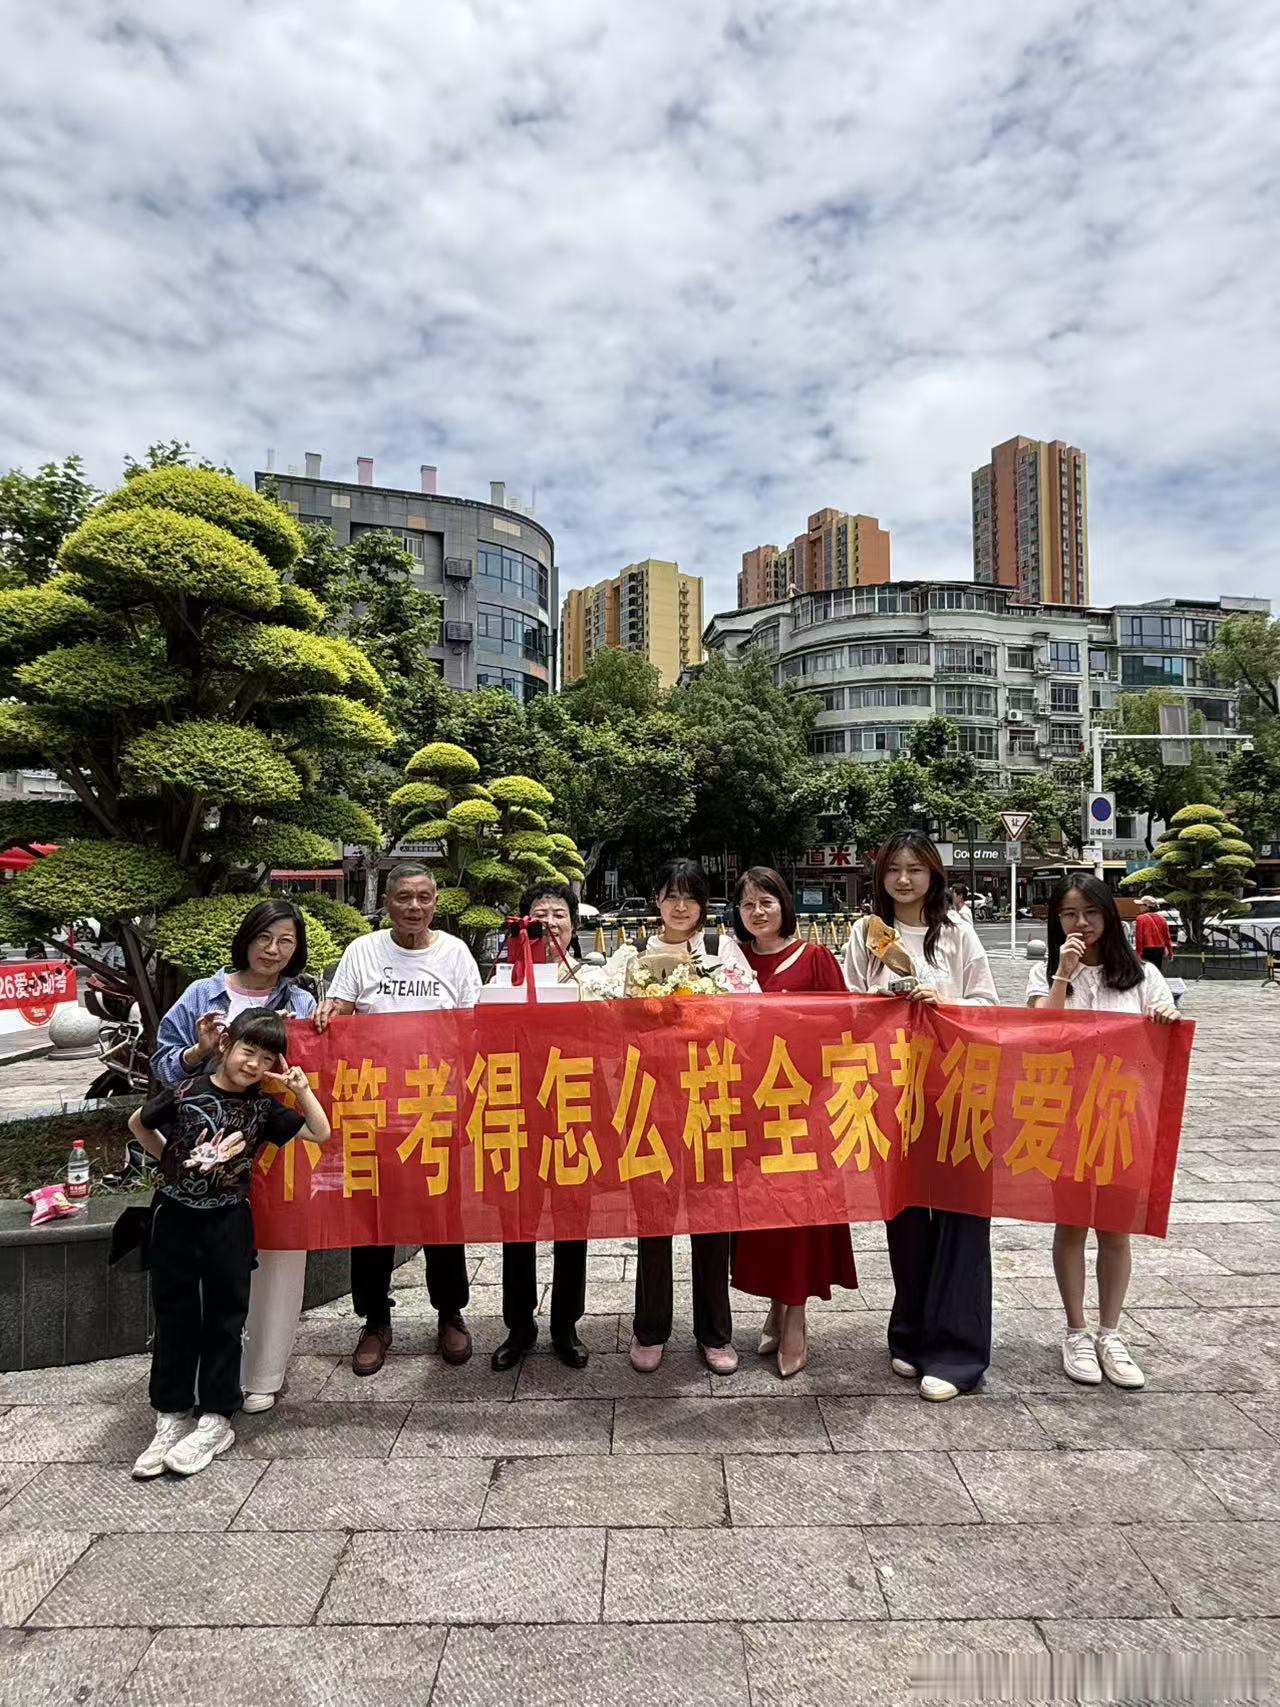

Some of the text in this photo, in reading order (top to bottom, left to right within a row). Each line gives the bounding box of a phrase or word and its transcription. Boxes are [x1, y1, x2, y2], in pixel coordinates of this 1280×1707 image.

[1011, 818, 1020, 827] 让
[953, 849, 999, 859] God me
